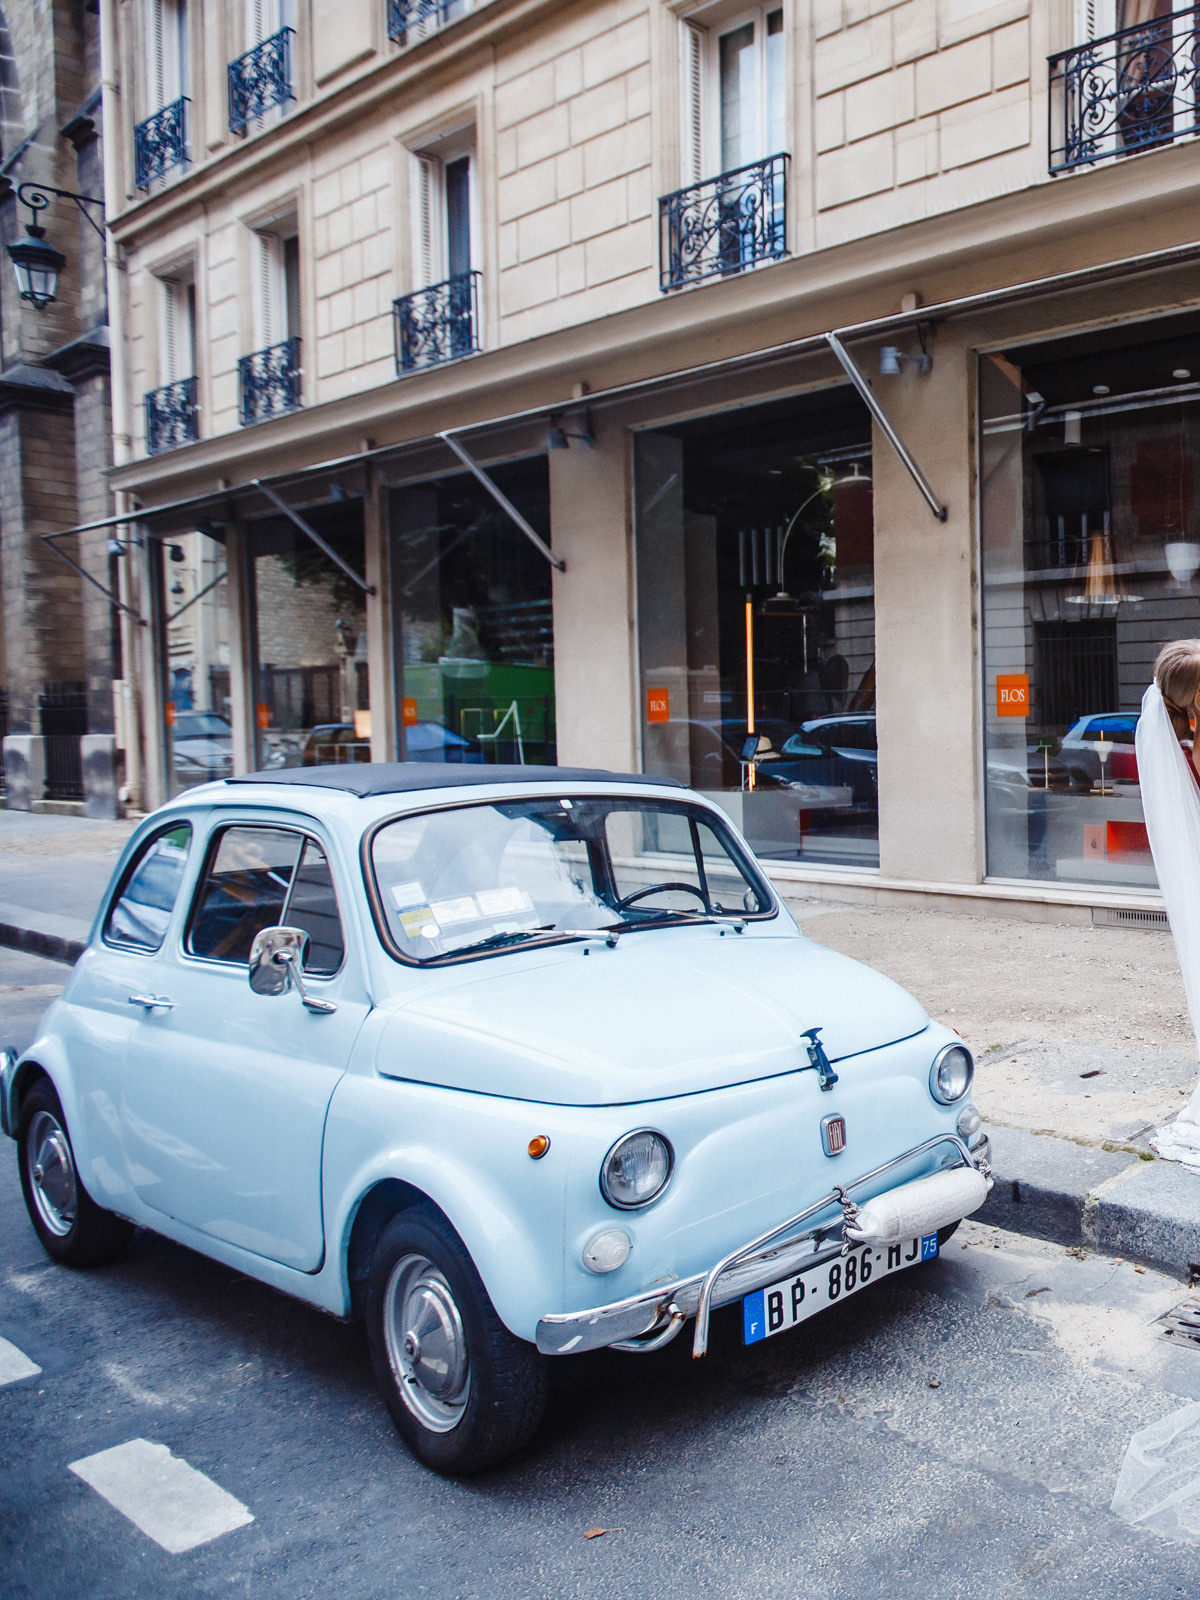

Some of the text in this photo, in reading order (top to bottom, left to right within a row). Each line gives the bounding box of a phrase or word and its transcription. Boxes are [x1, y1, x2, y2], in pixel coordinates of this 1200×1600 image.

[1000, 688, 1026, 703] FLOS
[828, 1121, 844, 1151] FIAT
[922, 1237, 937, 1256] 75
[750, 1321, 758, 1335] F
